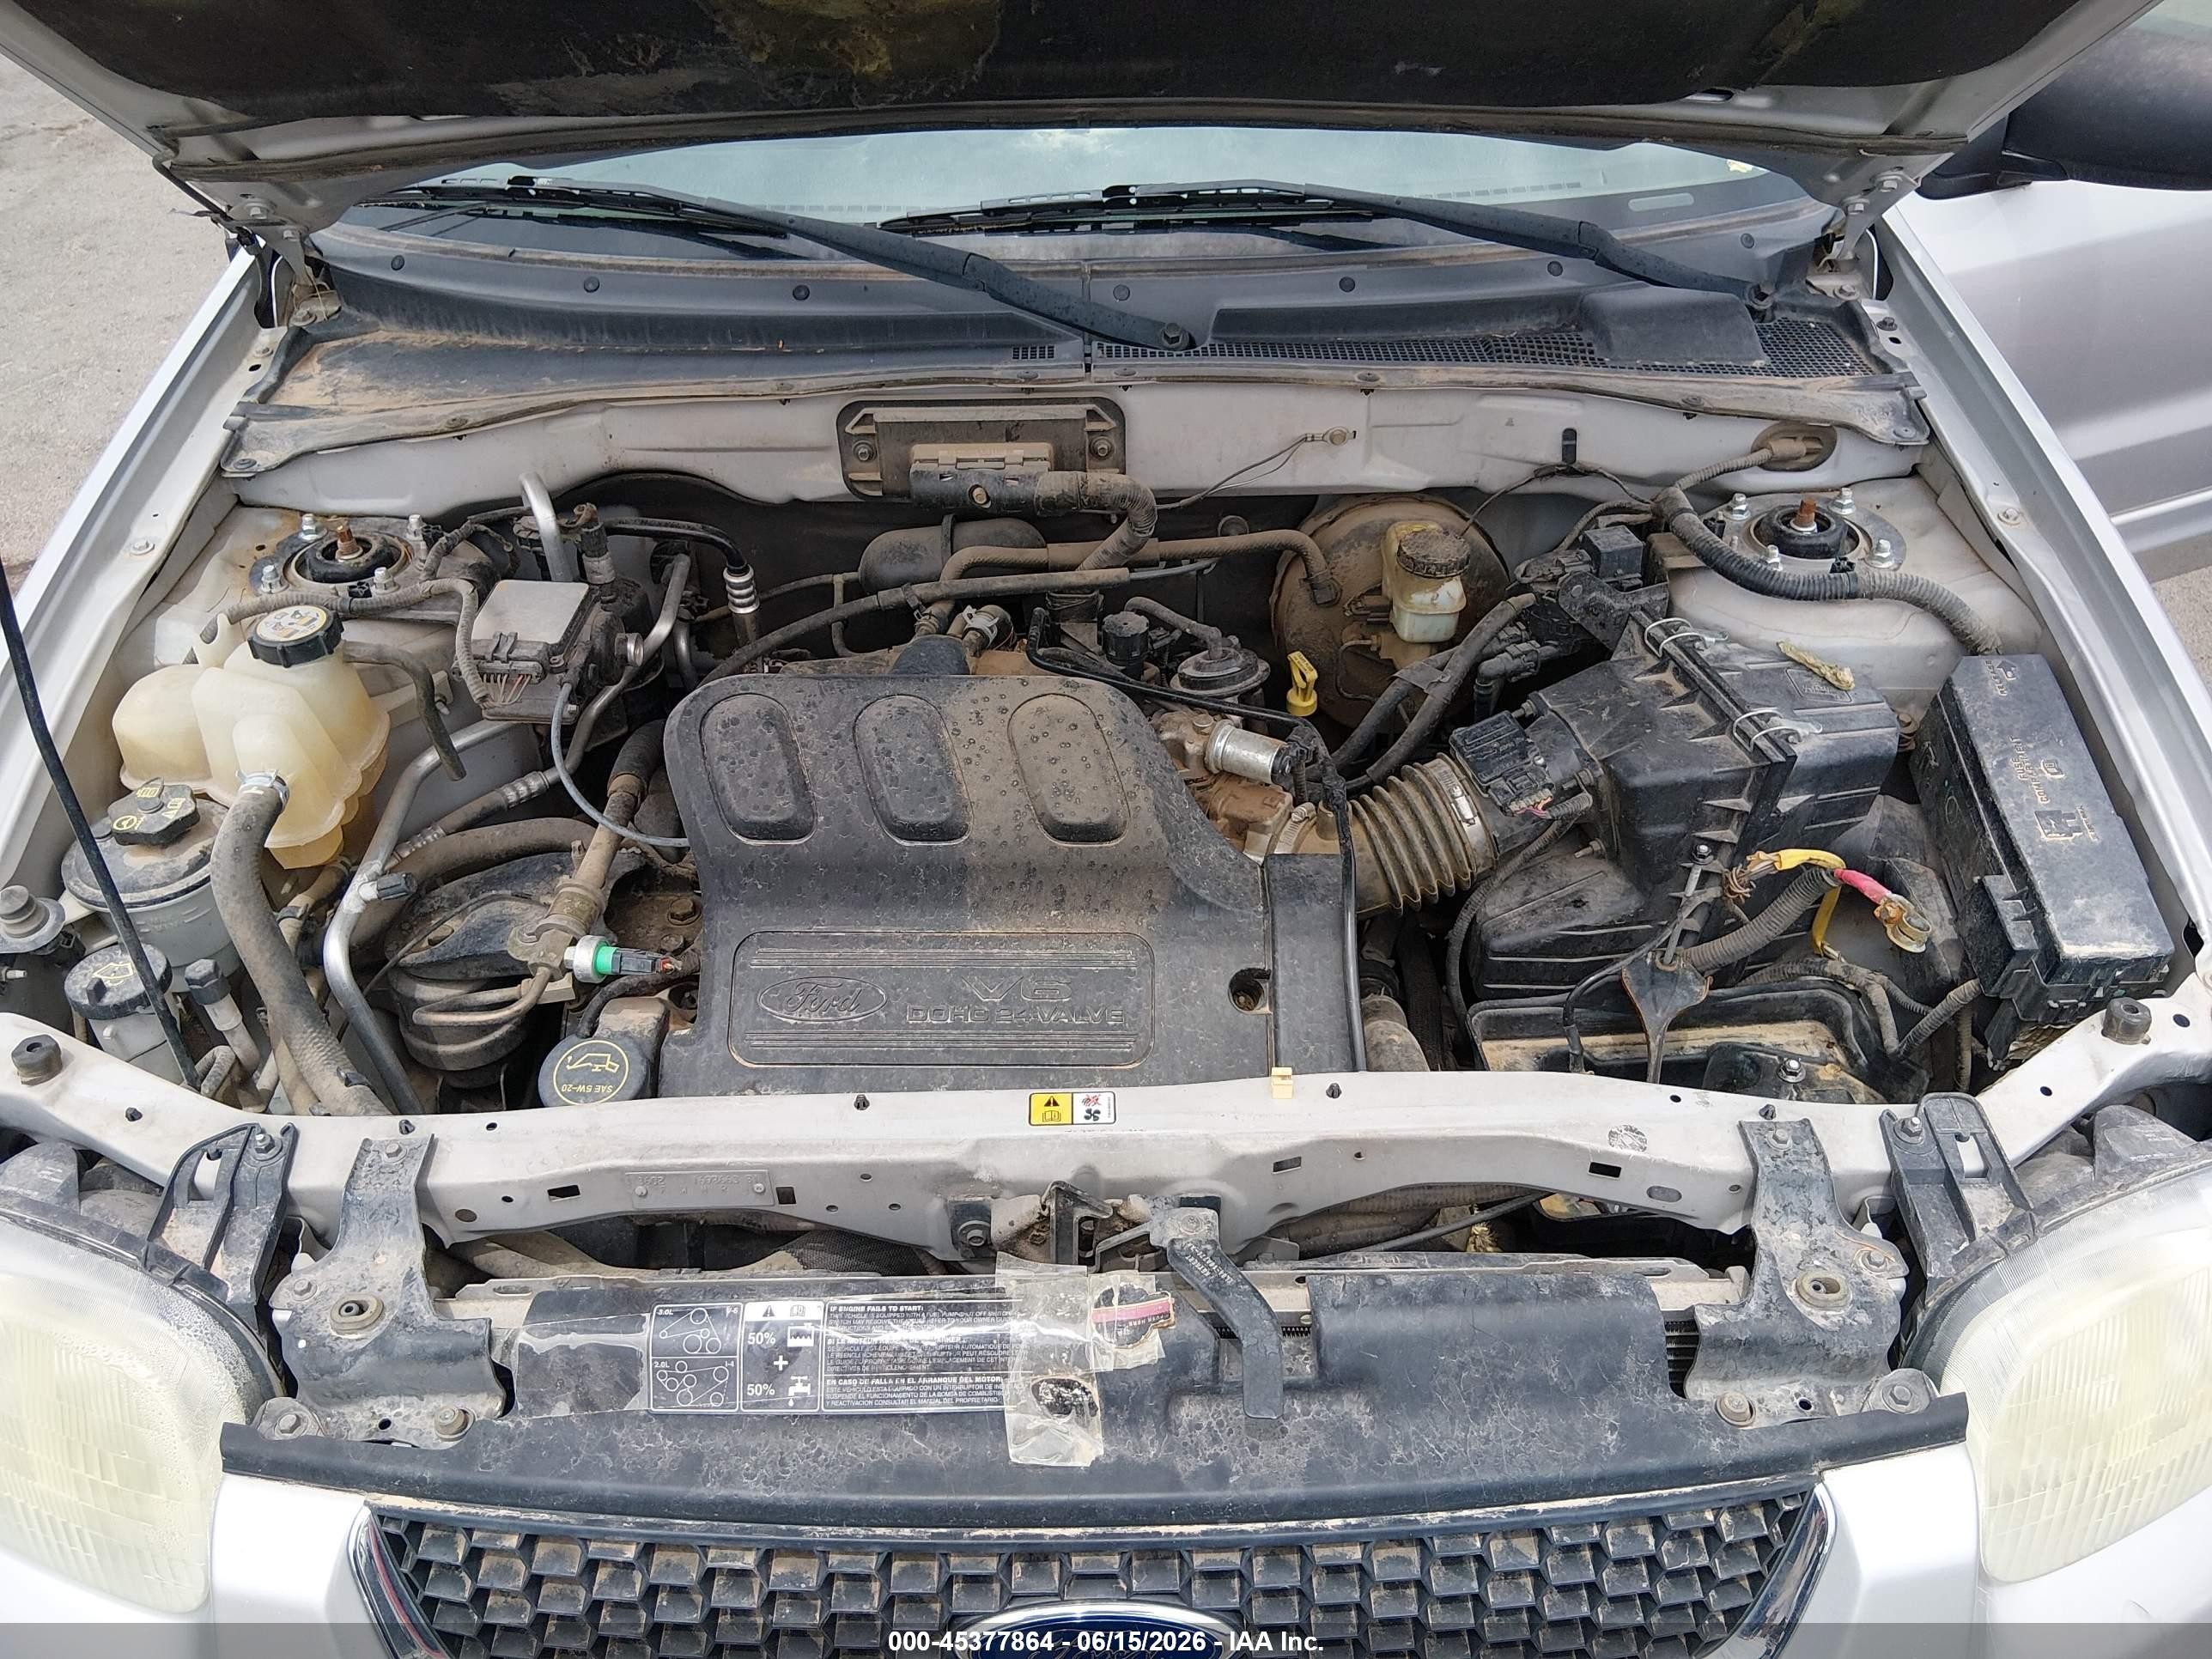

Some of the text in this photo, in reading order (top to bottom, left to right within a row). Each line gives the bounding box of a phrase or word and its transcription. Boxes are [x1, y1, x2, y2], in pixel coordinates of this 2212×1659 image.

[961, 975, 1073, 1001] V6
[782, 981, 863, 1012] Ford
[907, 1005, 989, 1024] DOHC
[561, 1084, 613, 1093] SAE 5W-20
[747, 1332, 776, 1345] 50%
[746, 1383, 775, 1396] 50%
